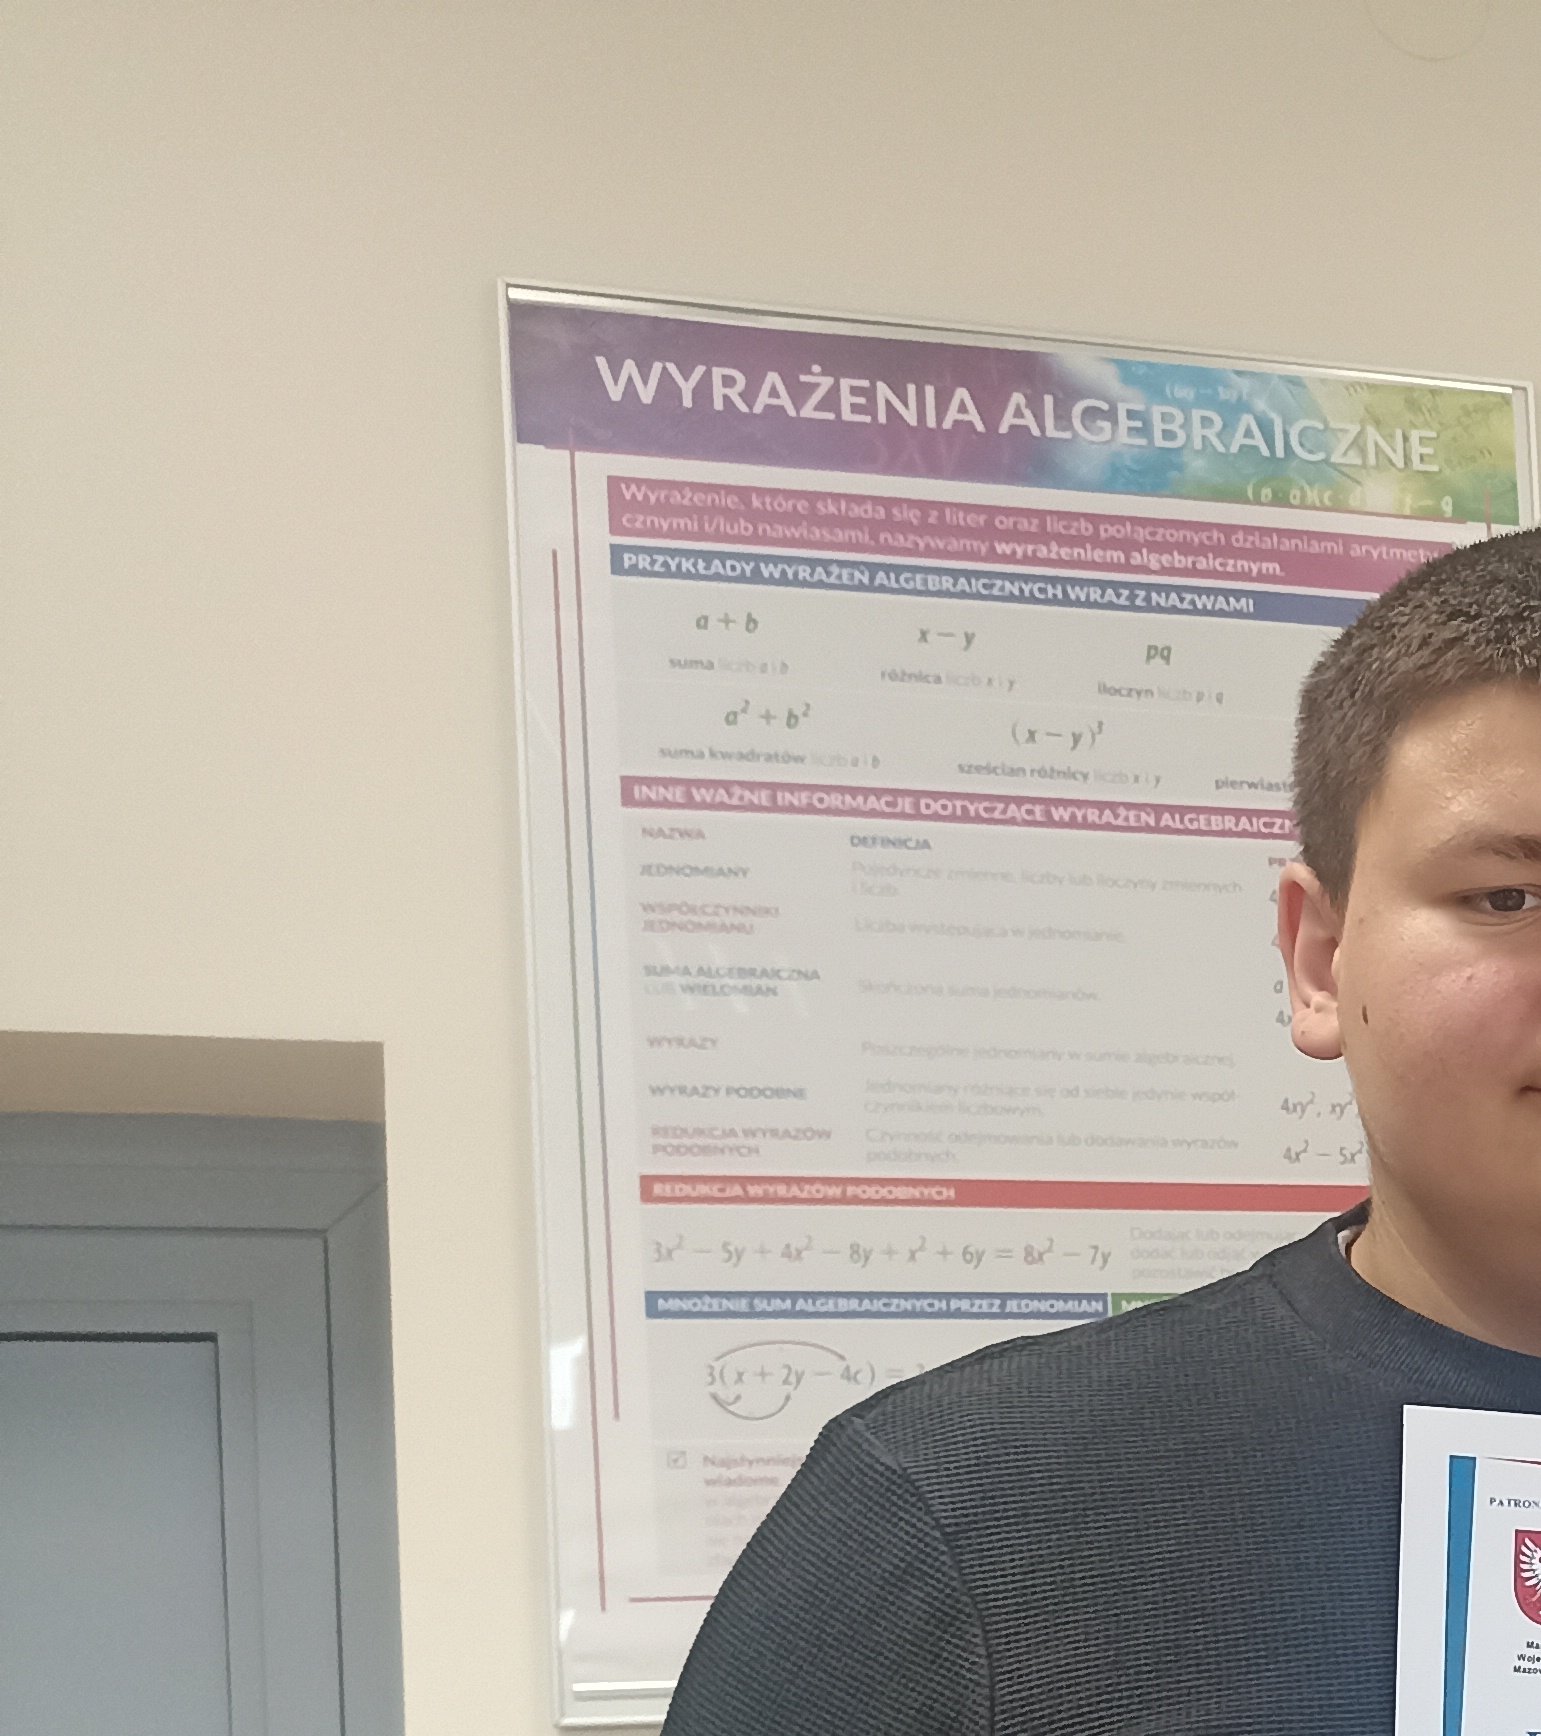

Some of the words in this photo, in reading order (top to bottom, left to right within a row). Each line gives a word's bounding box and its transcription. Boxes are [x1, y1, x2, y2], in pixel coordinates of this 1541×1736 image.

[594, 355, 986, 433] WYRAŻENIA
[999, 391, 1440, 473] ALGEBRAICZNE
[622, 552, 755, 577] PRZYKŁADY
[759, 562, 870, 586] WYRAŻEŃ
[873, 570, 1063, 600] ALGEBRAICZNYCH
[1066, 584, 1131, 606] WRAZ
[1134, 589, 1147, 607] Z
[1150, 591, 1254, 613] NAZWAMI
[633, 785, 685, 803] INNE
[691, 786, 770, 806] WAŻNE
[776, 791, 915, 814] INFORMACJE
[919, 798, 1046, 822] DOTYCZĄCE
[1050, 806, 1156, 827] WYRAŻEŃ
